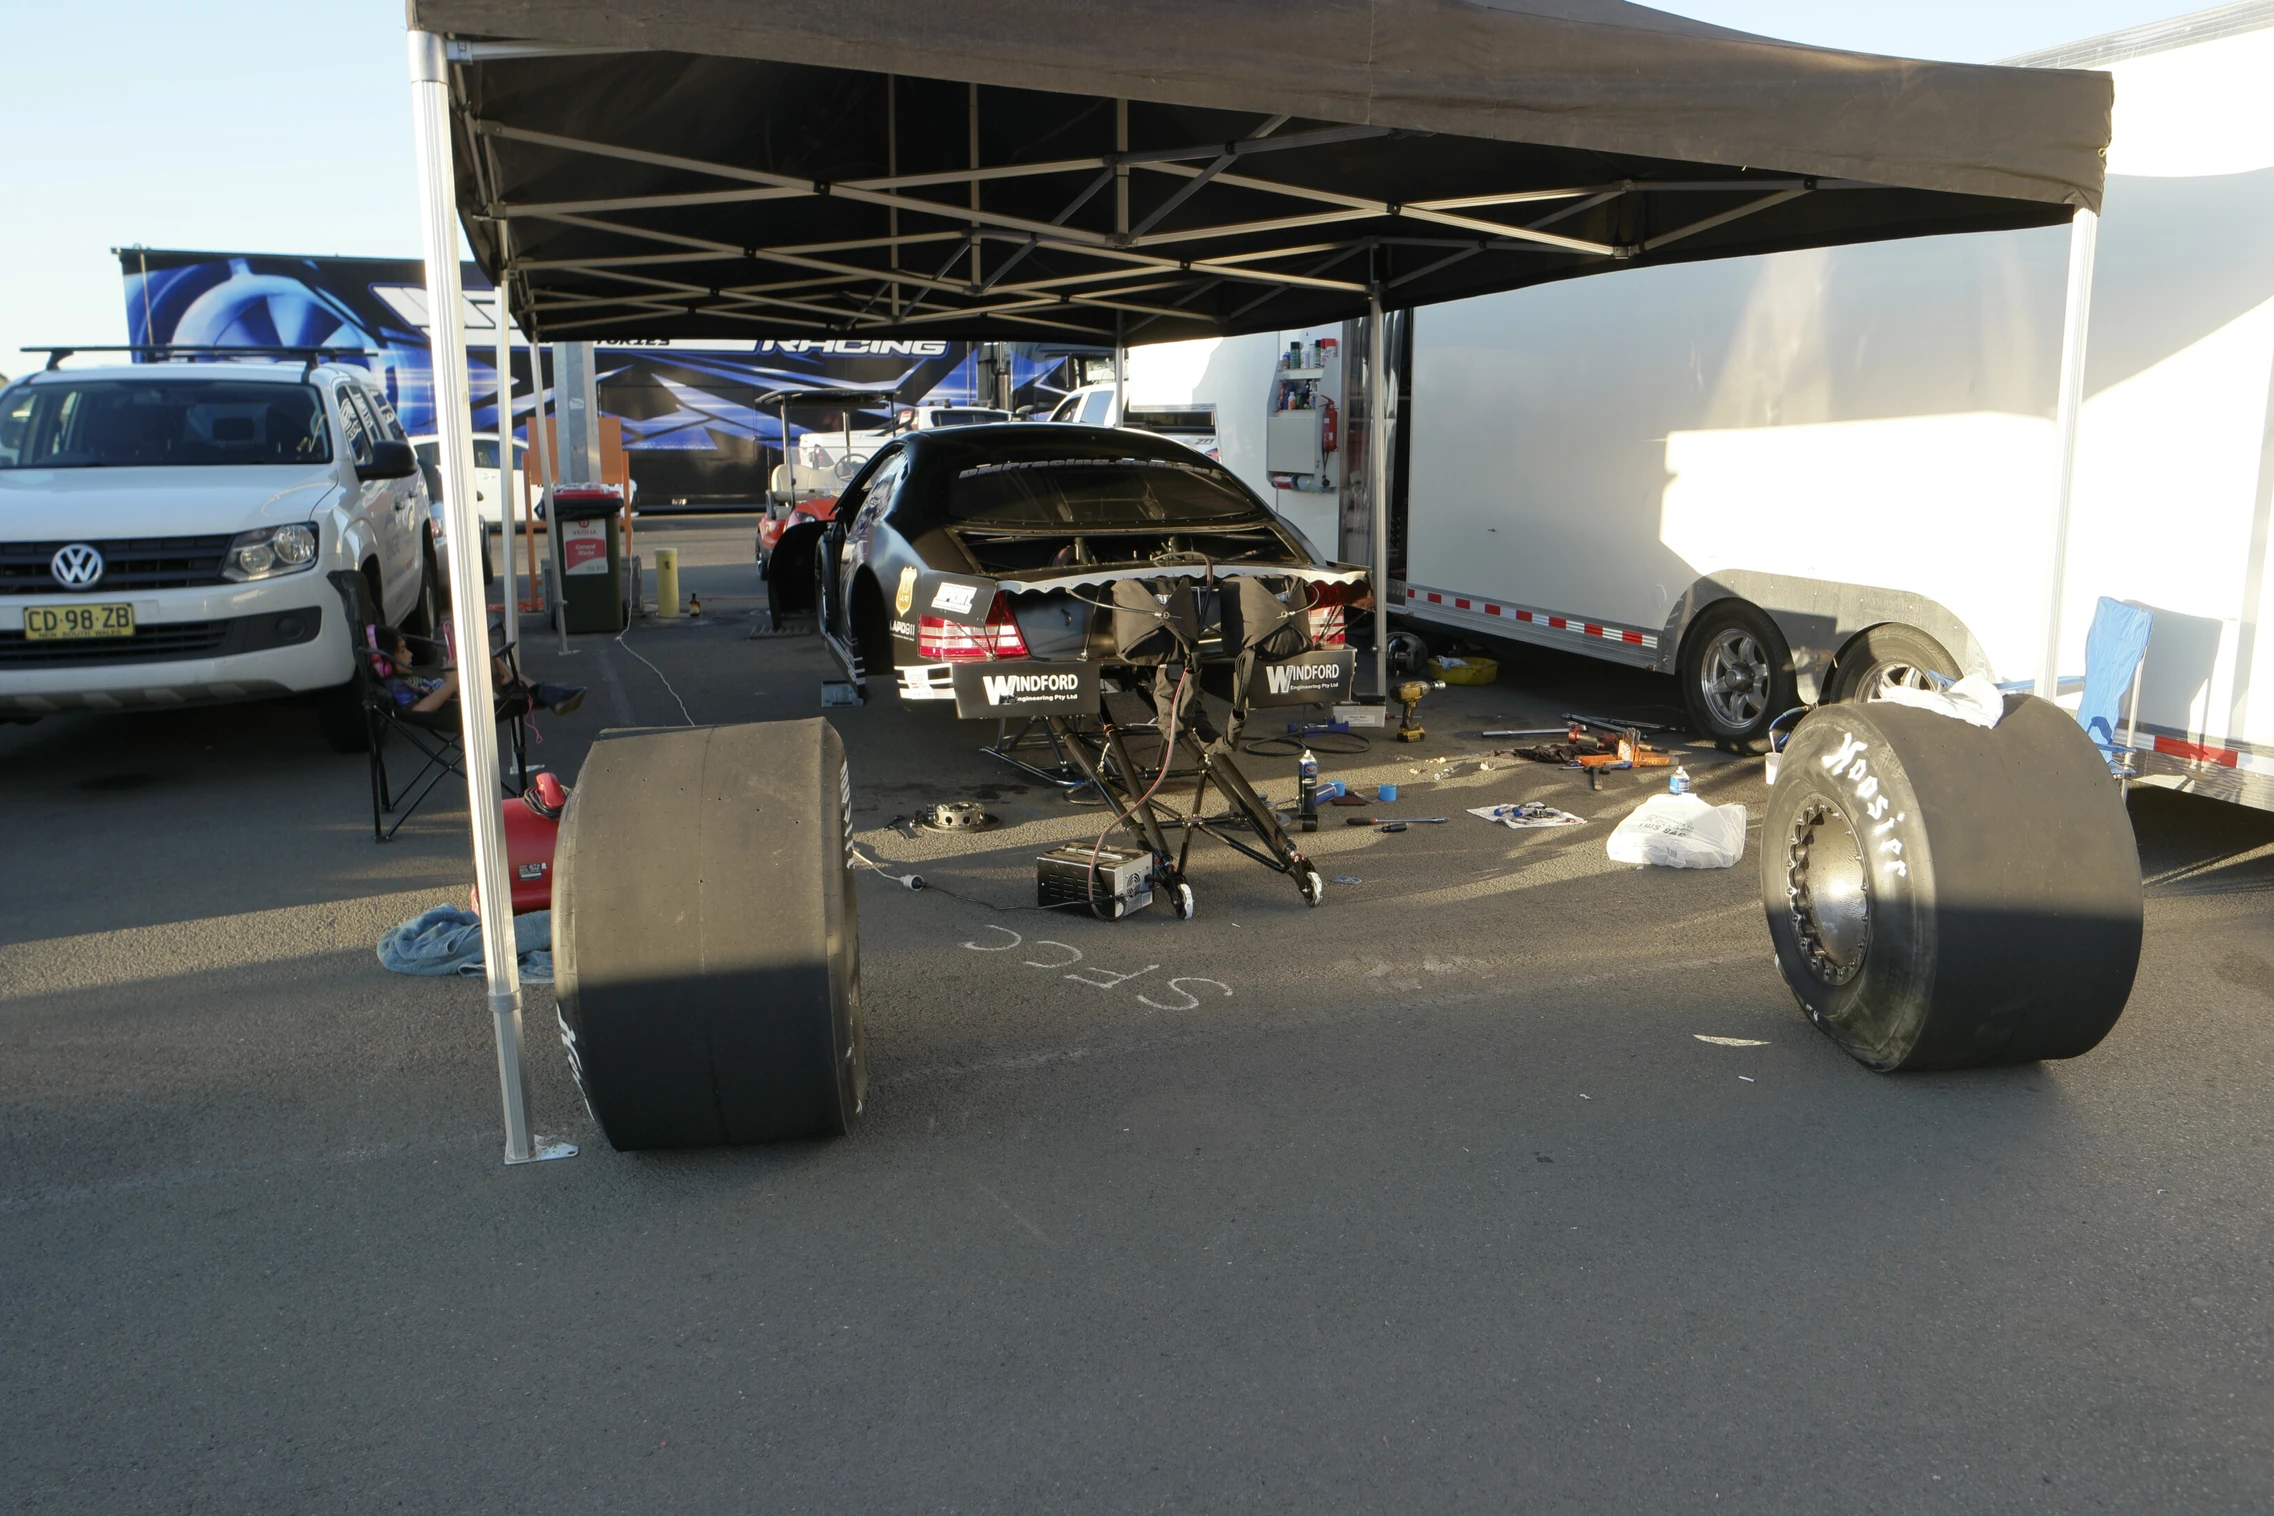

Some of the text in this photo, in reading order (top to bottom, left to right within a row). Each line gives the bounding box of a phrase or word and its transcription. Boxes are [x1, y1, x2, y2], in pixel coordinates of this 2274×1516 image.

[1266, 663, 1340, 694] WINDFORD
[1290, 683, 1321, 691] Engineering
[982, 673, 1079, 706] WINDFORD
[1017, 694, 1053, 702] ngineering
